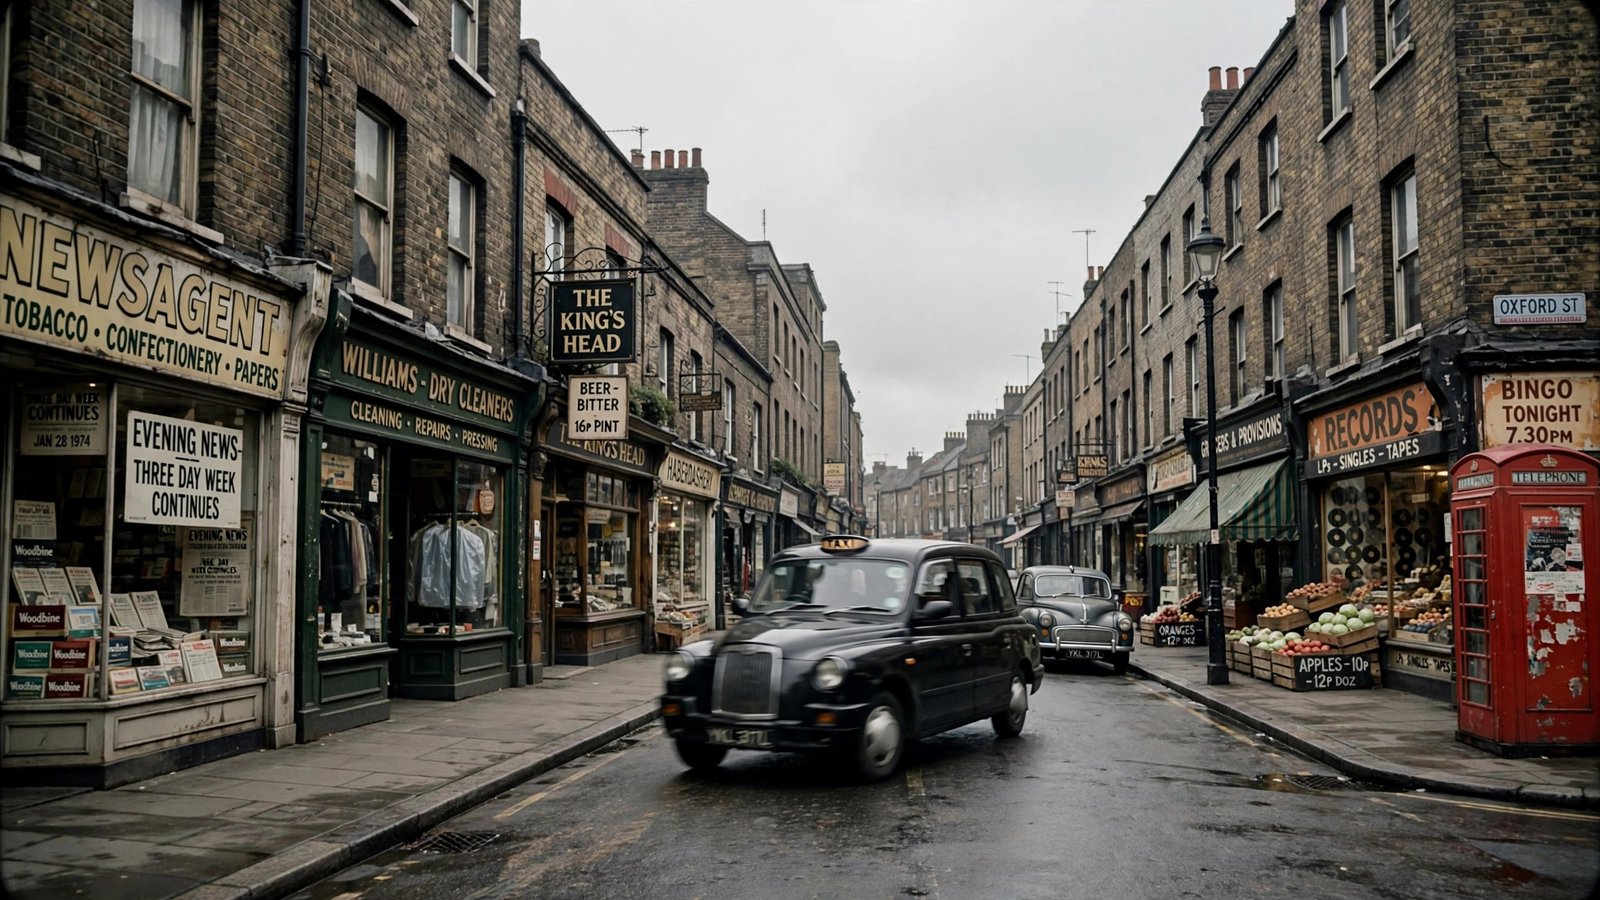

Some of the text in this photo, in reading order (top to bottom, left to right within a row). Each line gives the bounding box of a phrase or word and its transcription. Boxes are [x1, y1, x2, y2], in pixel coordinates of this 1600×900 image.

[0, 204, 280, 356] NEWSAGENT
[573, 288, 613, 307] THE
[1500, 297, 1578, 315] OXFORD ST
[560, 309, 626, 331] KING'S
[3, 294, 279, 391] TOBACCO CONFECTIONERY PAPERS
[563, 334, 622, 354] HEAD
[343, 341, 418, 394] WILLIAMS
[429, 372, 456, 405] DRY
[459, 383, 514, 423] CLEANERS
[580, 382, 611, 395] BEER
[1502, 379, 1573, 400] BINGO
[29, 405, 99, 421] CONTINUES
[577, 398, 619, 411] BITTER
[1324, 389, 1419, 452] RECORDS
[1502, 405, 1582, 423] TONIGHT
[351, 400, 498, 453] CLEANING REPAIRS PRESSING
[593, 419, 619, 433] PINT
[1231, 430, 1237, 449] &
[1238, 413, 1282, 447] PROVISIONS
[1505, 426, 1573, 444] 7.30PM
[33, 434, 91, 447] JAN 28 1974
[133, 418, 196, 456] EVENING
[619, 442, 645, 466] HEAD
[1317, 459, 1331, 475] LPs
[1339, 448, 1375, 470] SINGLES
[1386, 438, 1420, 460] TAPES
[134, 459, 236, 494] THREE DAY WEEK
[1514, 471, 1583, 483] TELEPHONE
[152, 491, 220, 520] CONTINUES
[225, 529, 248, 542] NEWS
[14, 544, 53, 557] Woodbine
[19, 612, 60, 623] Woodbine
[1159, 625, 1195, 636] ORANGES
[17, 649, 48, 658] Woodbine
[53, 649, 86, 659] Woodbine
[1299, 657, 1343, 673] APPLES
[9, 681, 42, 691] Woodbine
[48, 681, 81, 692] Woodbine
[1335, 675, 1356, 687] DOZ
